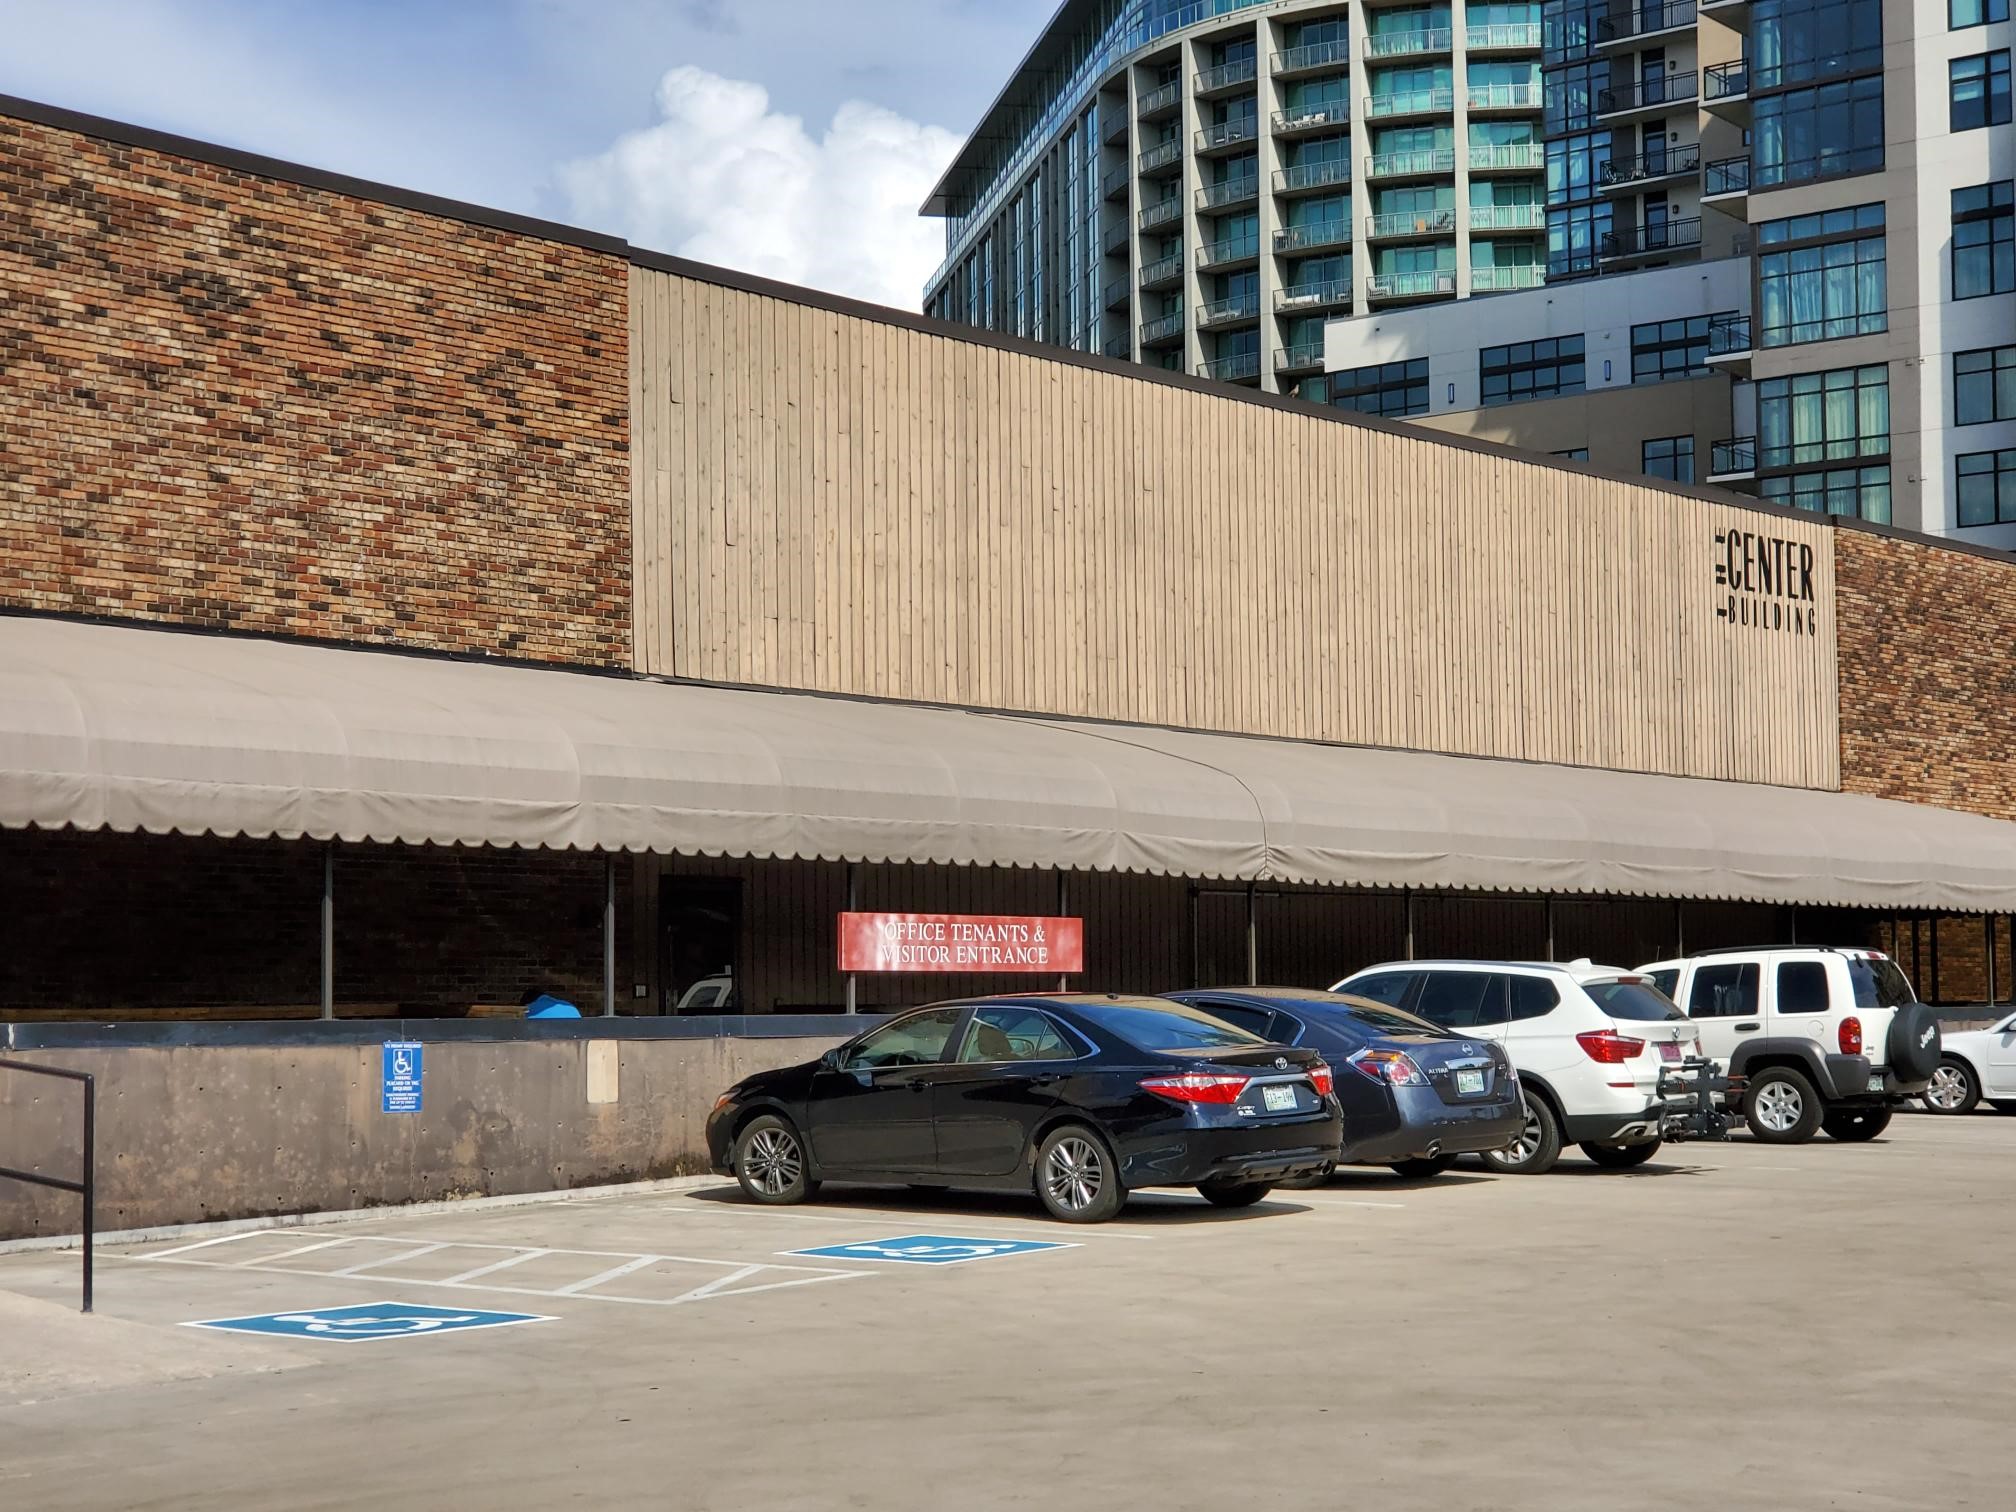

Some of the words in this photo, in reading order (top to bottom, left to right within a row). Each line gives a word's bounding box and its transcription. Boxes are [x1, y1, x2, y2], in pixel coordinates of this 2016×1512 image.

[1727, 528, 1814, 602] CENTER
[1728, 595, 1816, 637] BUILDING
[884, 922, 946, 941] OFFICE
[951, 923, 1028, 942] TENANTS
[1033, 925, 1046, 942] &
[881, 945, 951, 963] VISITOR
[956, 946, 1049, 964] ENTRANCE
